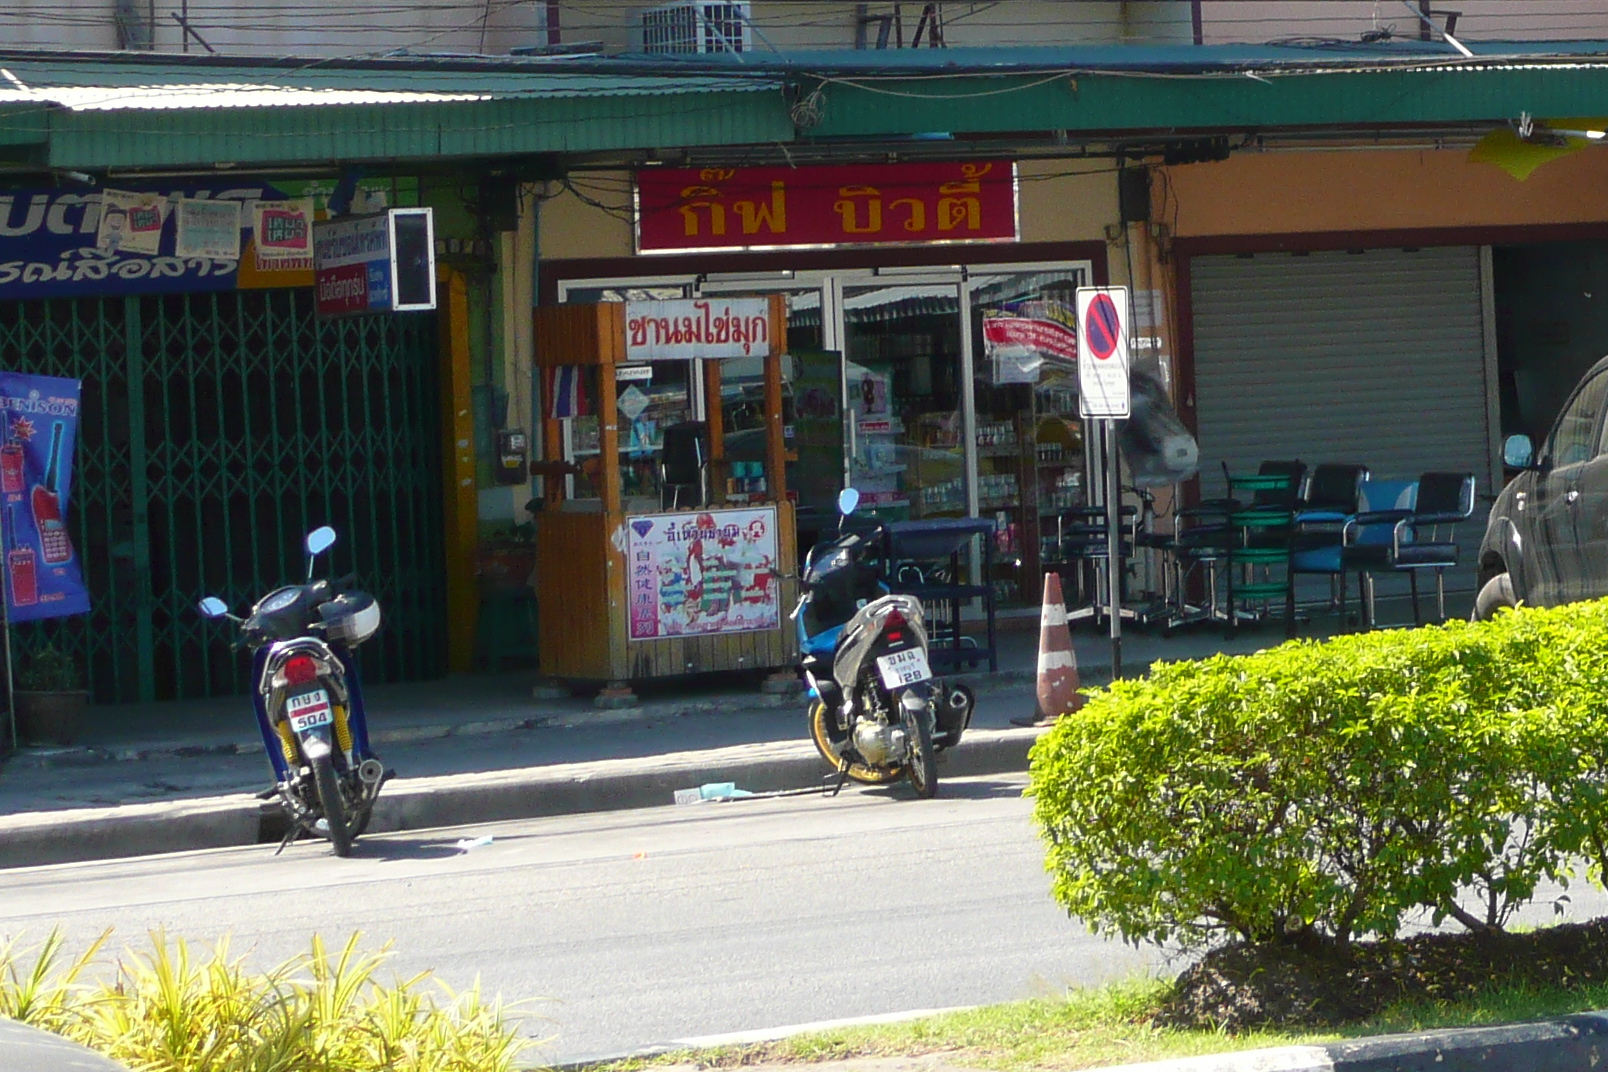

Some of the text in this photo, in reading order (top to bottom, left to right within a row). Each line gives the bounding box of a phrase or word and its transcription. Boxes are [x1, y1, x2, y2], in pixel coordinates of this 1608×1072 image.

[679, 161, 992, 236] กิ๊ฟ บิวตี้
[629, 301, 767, 355] ชานมไข่มุก
